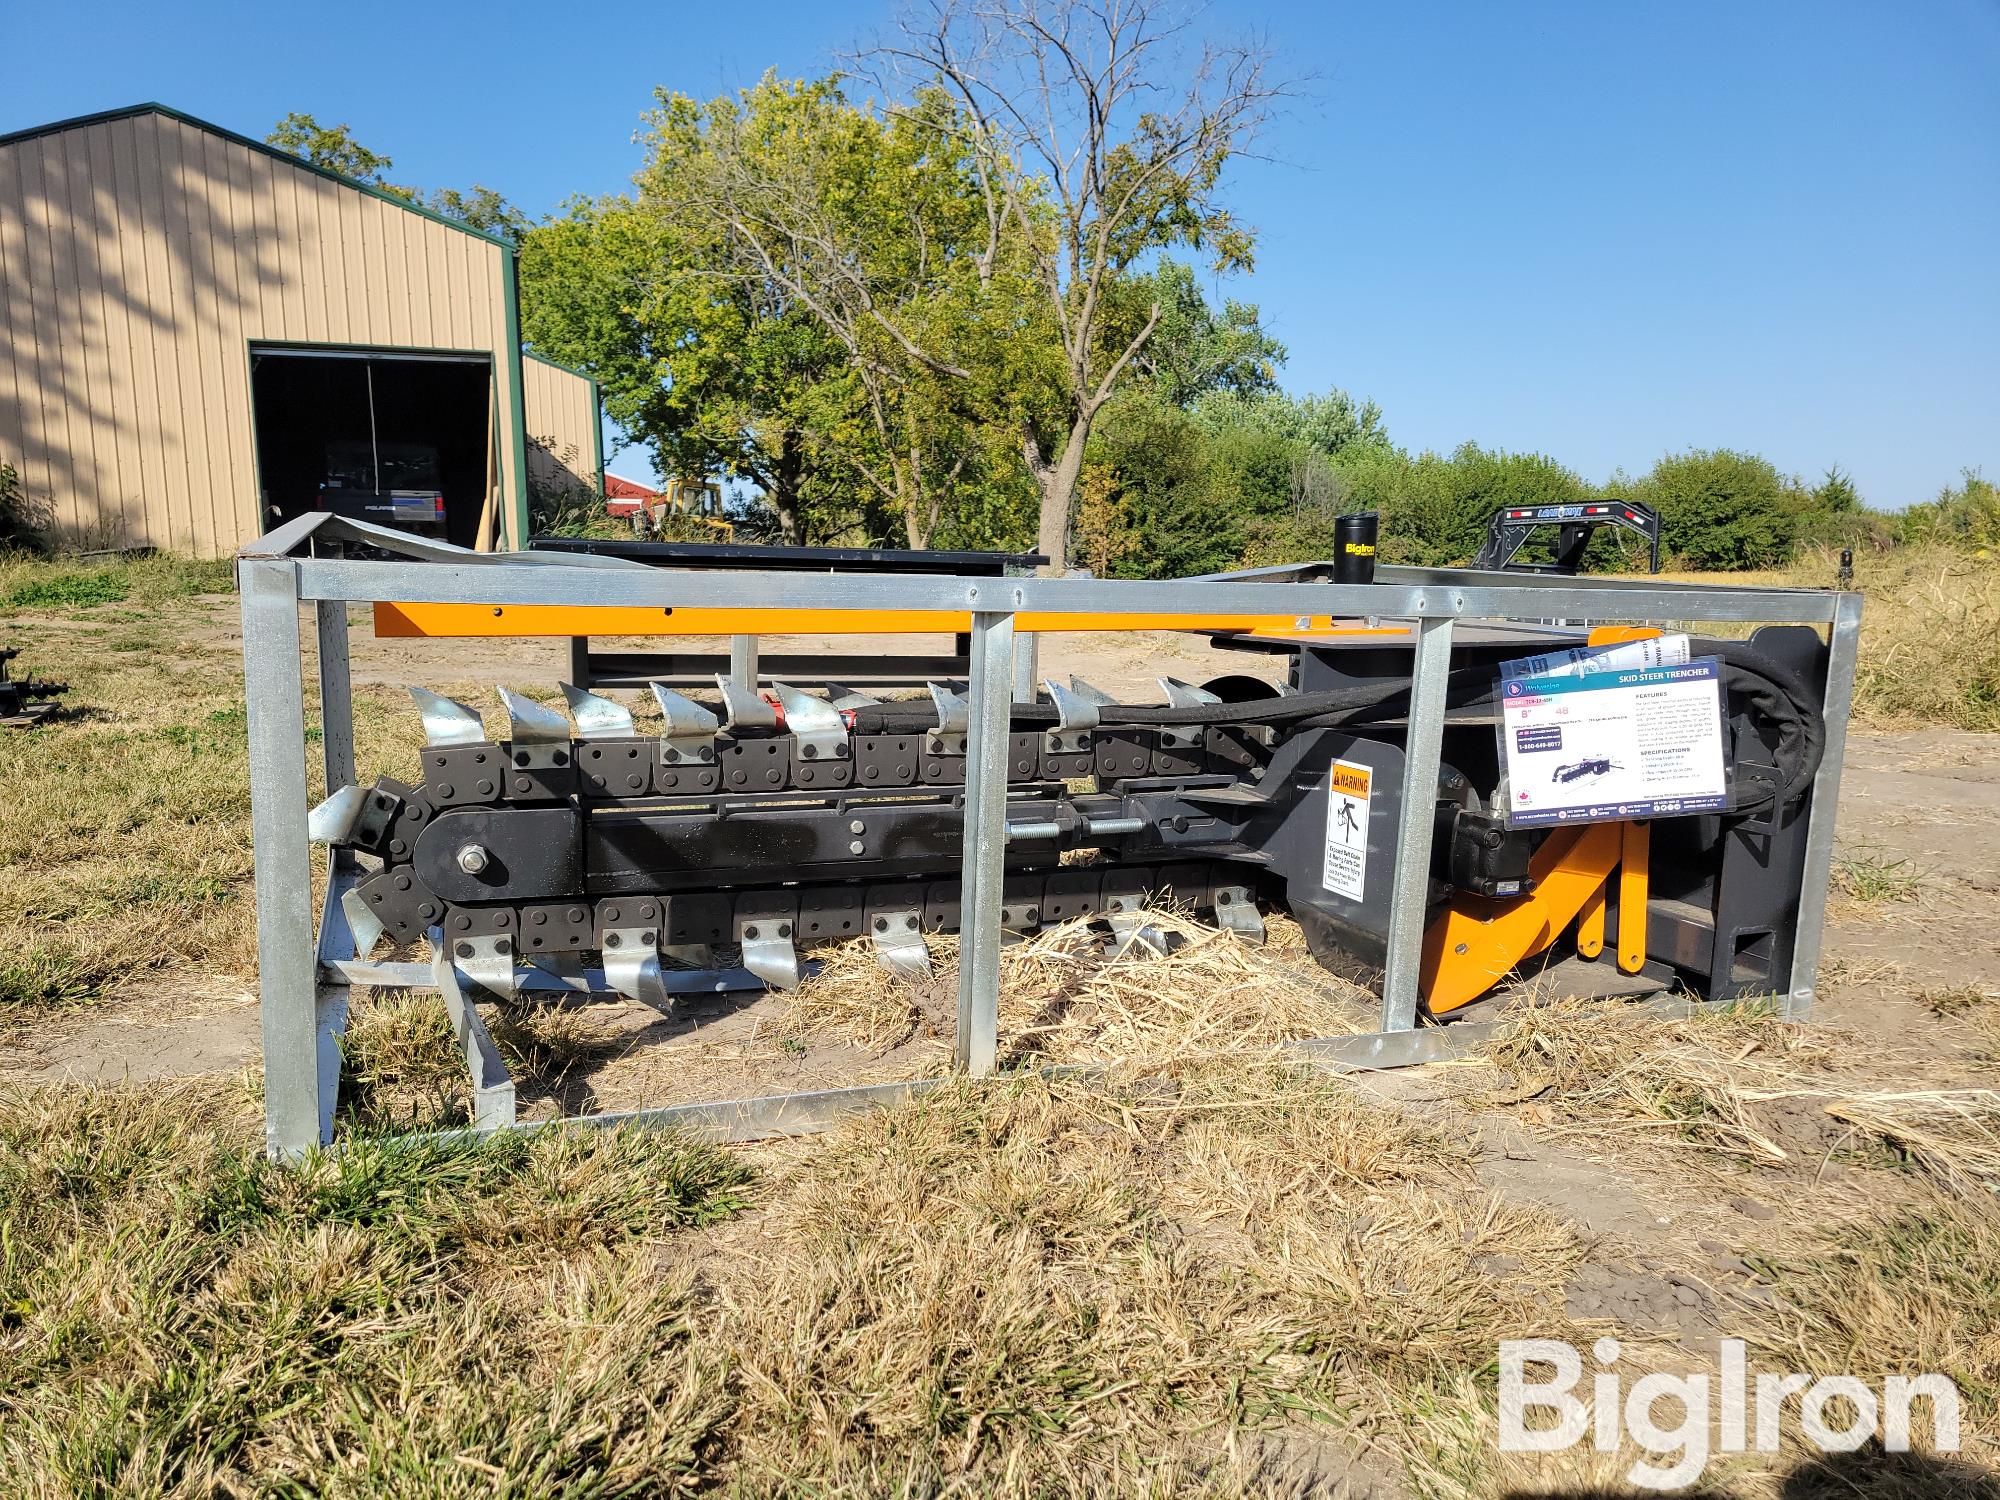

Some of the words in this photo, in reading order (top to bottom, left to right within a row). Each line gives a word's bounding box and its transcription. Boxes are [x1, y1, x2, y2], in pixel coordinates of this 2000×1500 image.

[1619, 674, 1638, 683] SKID
[1640, 672, 1664, 682] STEER
[1665, 668, 1709, 680] TRENCHER
[1635, 691, 1668, 699] FEATURES
[1340, 774, 1368, 793] WARNING
